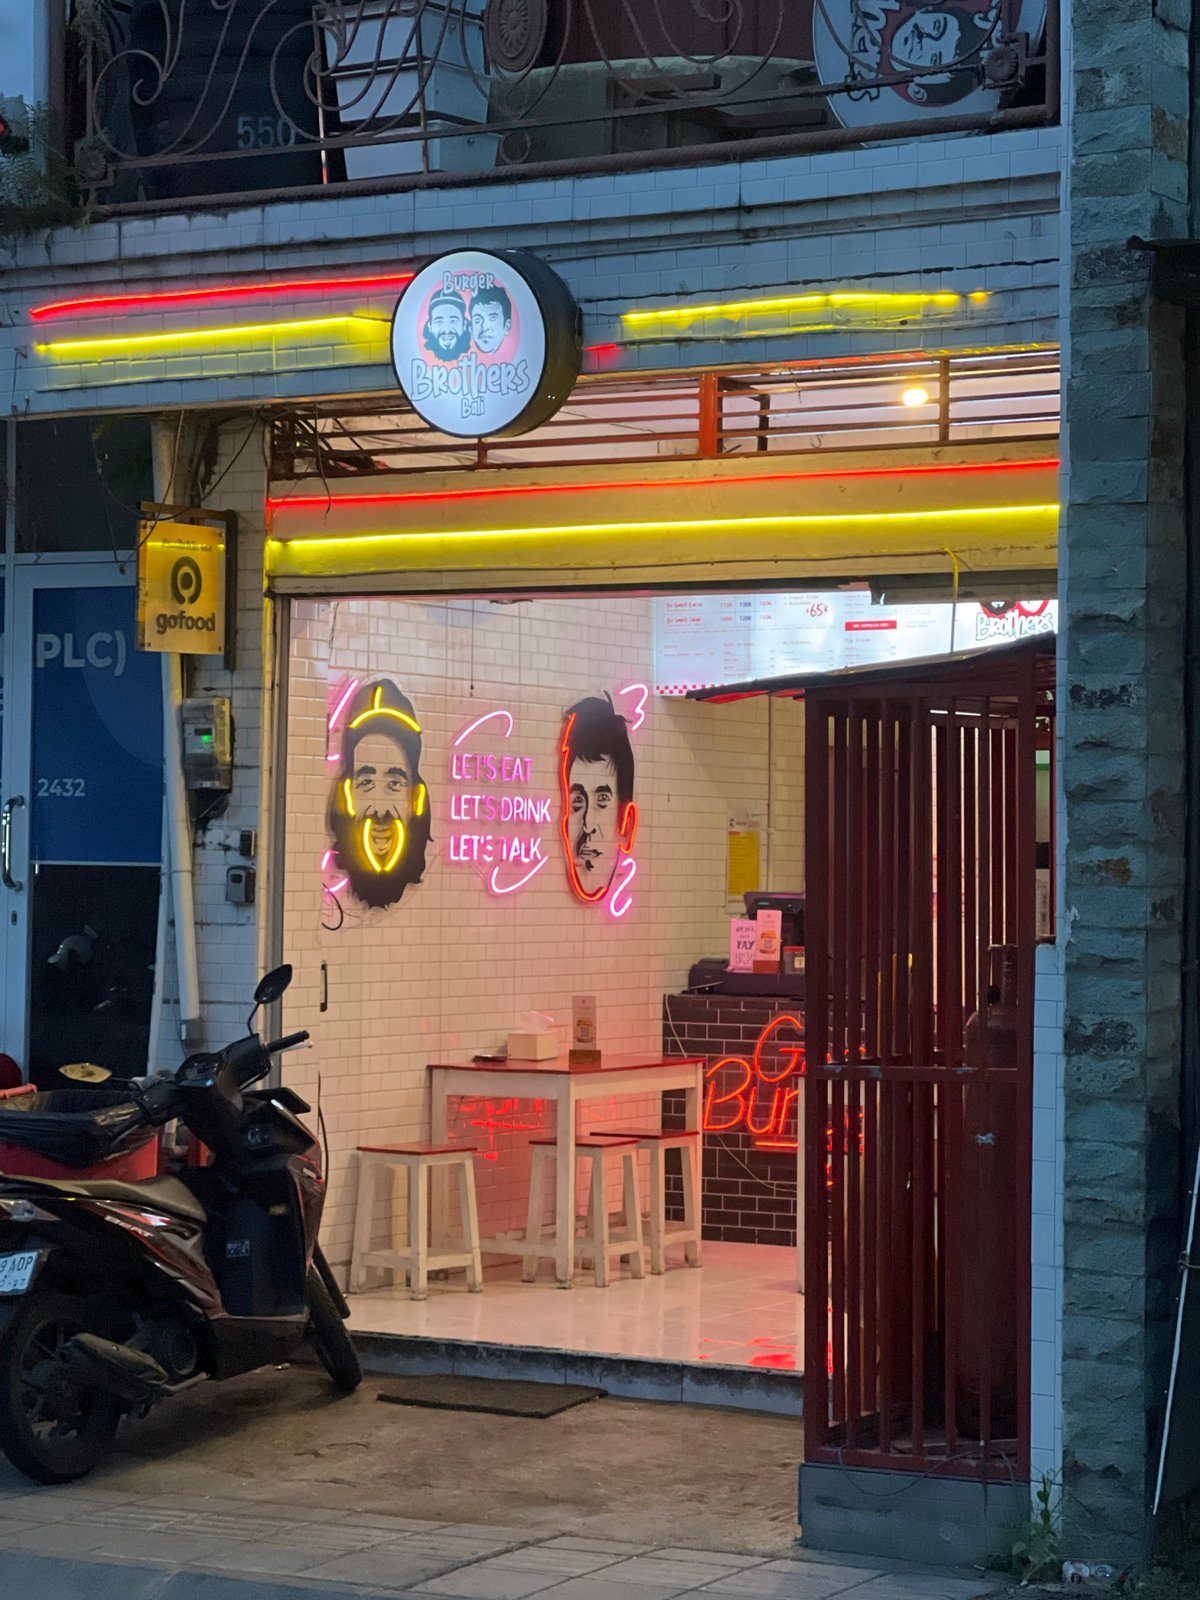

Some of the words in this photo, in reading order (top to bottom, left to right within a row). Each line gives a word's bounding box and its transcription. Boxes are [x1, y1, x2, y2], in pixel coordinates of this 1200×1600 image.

[237, 116, 296, 148] 550
[442, 270, 496, 297] Burger
[410, 351, 531, 402] Brothers
[460, 395, 486, 419] Bali
[156, 610, 216, 636] gofood
[975, 607, 1054, 641] Brothers
[452, 753, 497, 780] LET'S
[502, 756, 533, 784] EAT
[37, 778, 86, 797] 2432
[451, 794, 497, 821] LET'S
[501, 796, 551, 823] DRINK
[450, 834, 494, 862] LET'S
[500, 836, 541, 863] TALK
[736, 940, 755, 950] PAY
[703, 1057, 799, 1135] Bur
[8, 1255, 34, 1272] ADP
